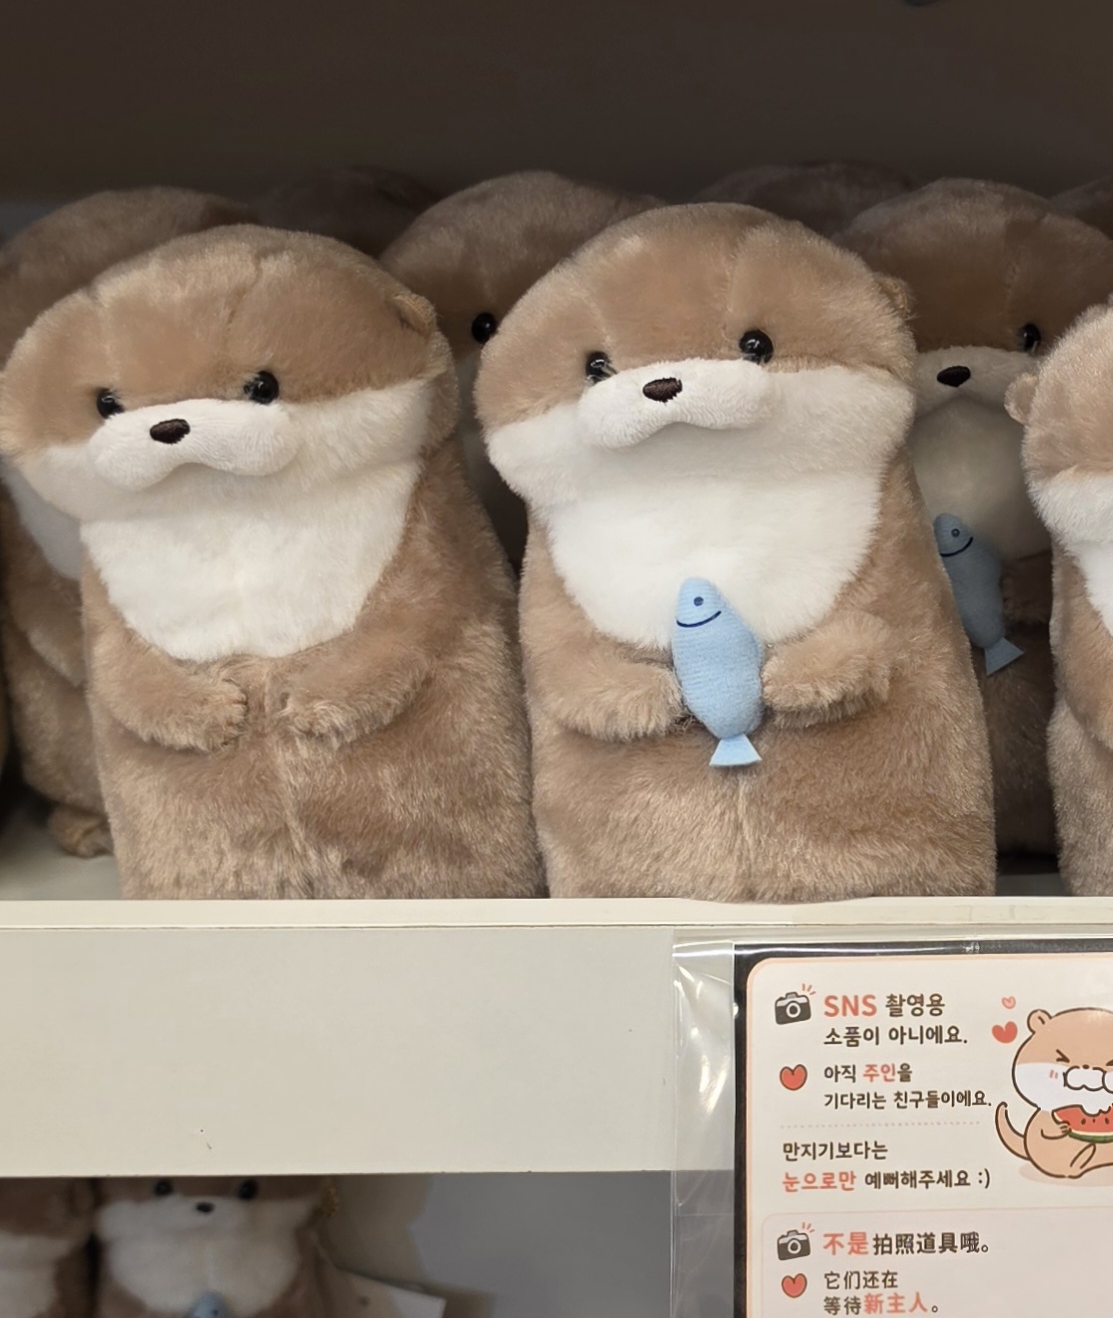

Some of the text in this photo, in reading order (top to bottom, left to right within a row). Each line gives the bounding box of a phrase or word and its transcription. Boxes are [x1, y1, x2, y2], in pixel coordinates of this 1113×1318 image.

[824, 993, 945, 1017] SNS 촬영용
[823, 1025, 968, 1047] 소품이 아니에요.
[824, 1063, 912, 1083] 아직 주인을
[824, 1090, 992, 1110] 기다리는 친구들이에요.
[783, 1141, 888, 1162] 만지기보다는
[782, 1171, 857, 1193] 눈으로만
[864, 1170, 971, 1190] 예뻐해주세요
[823, 1231, 989, 1256] 不是拍照道具哦。
[824, 1270, 899, 1290] 它们还在
[823, 1292, 939, 1316] 等待新主人。
